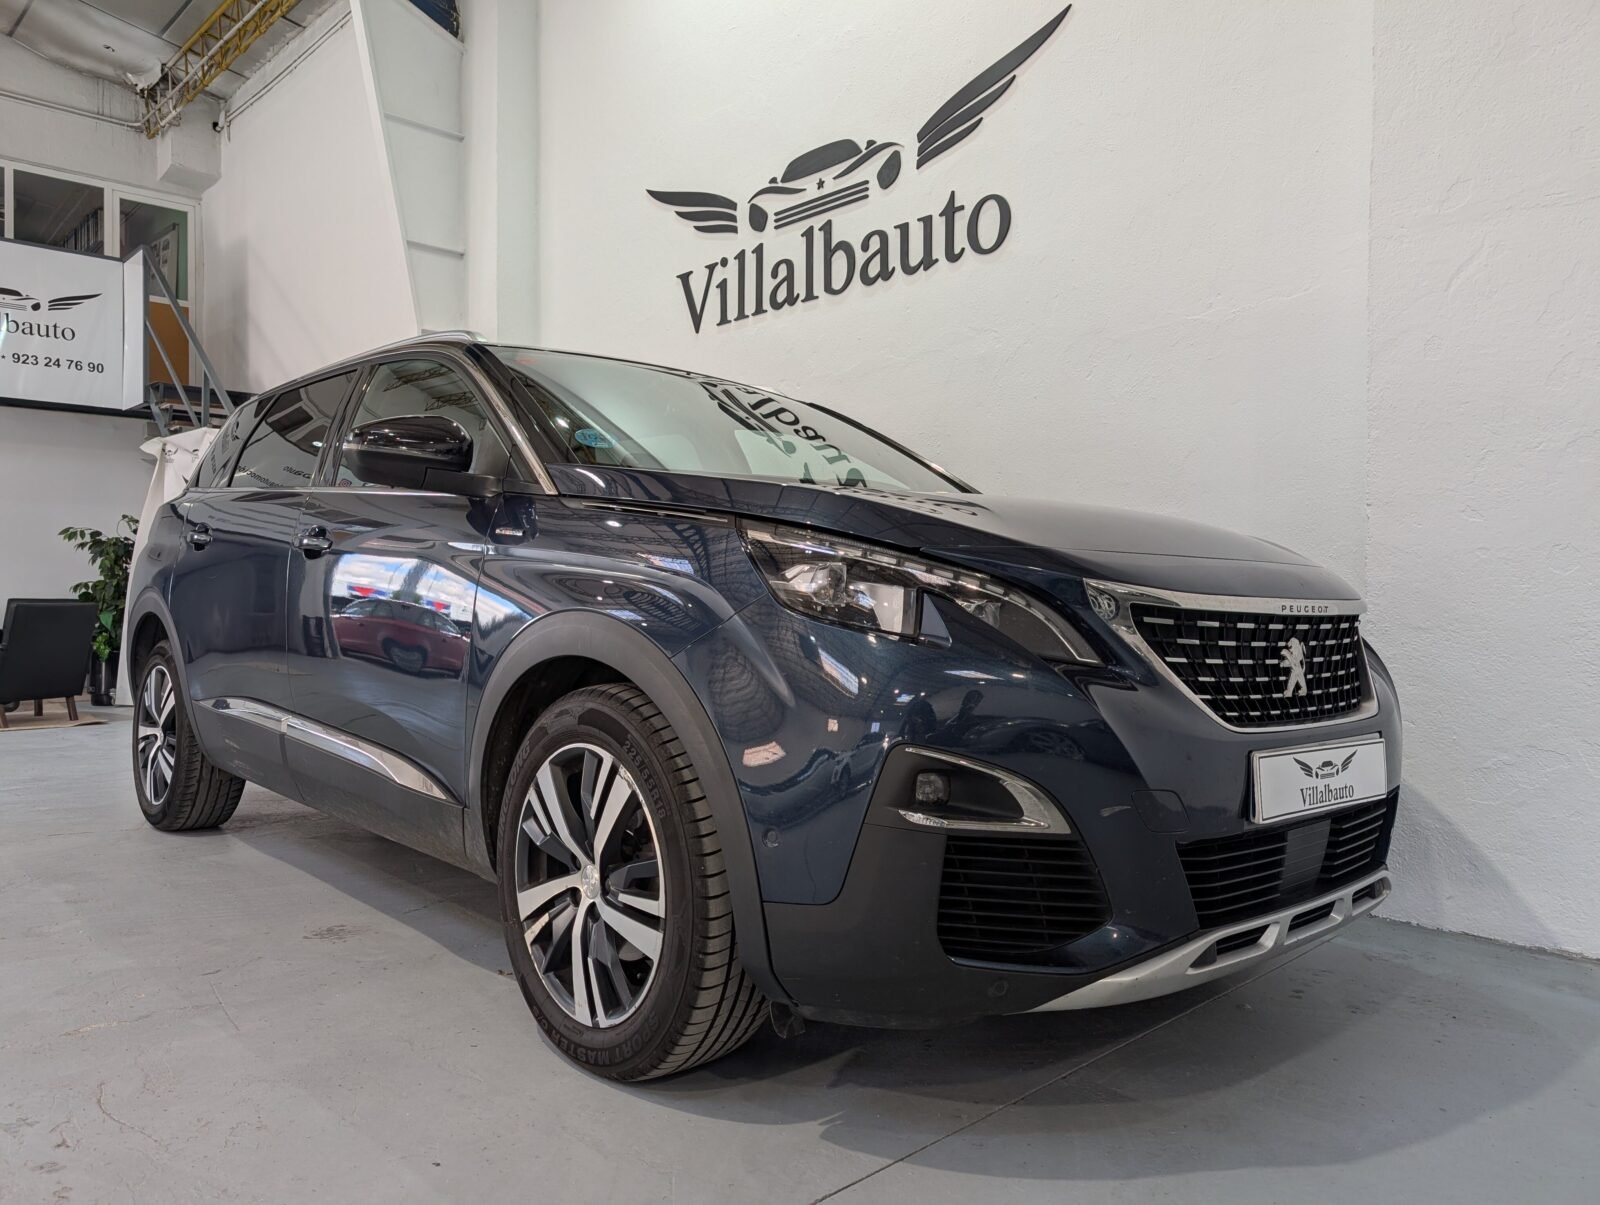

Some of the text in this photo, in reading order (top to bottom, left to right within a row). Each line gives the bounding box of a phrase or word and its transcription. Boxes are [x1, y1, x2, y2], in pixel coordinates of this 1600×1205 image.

[676, 189, 1012, 334] Villalbauto
[0, 312, 76, 341] bauto
[11, 352, 104, 374] 923 24 76 90
[1281, 604, 1330, 614] PEUGEOT
[1300, 783, 1355, 807] Villalbauto
[550, 1029, 610, 1065] MASTER
